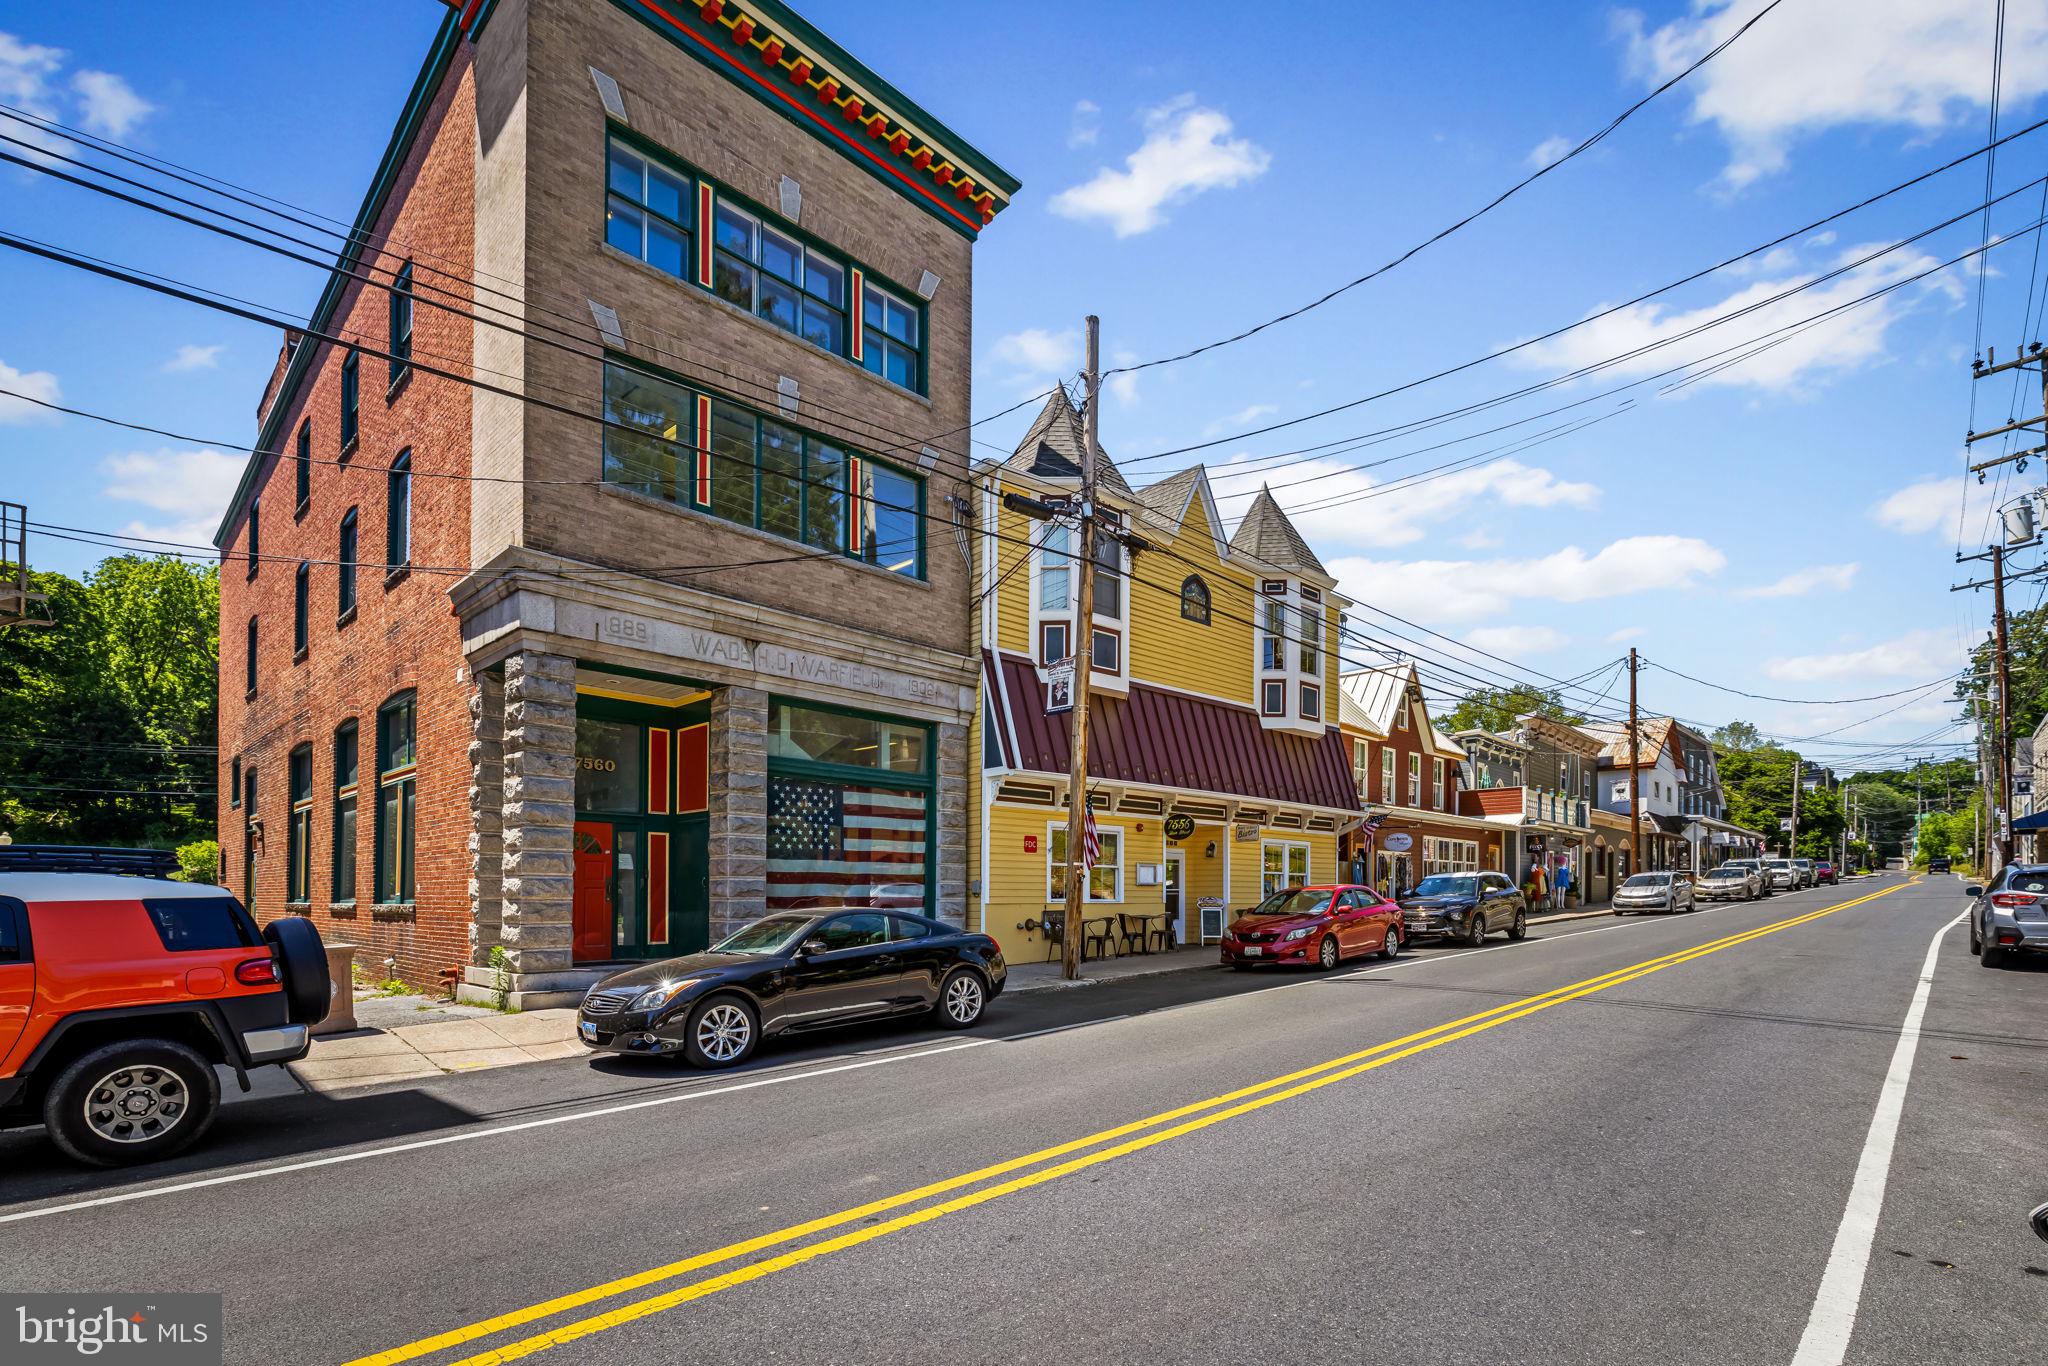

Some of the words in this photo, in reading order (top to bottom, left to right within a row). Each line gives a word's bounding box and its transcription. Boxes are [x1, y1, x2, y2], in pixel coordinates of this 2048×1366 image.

[795, 654, 880, 689] WARFIELD
[575, 756, 616, 772] 7560
[1167, 818, 1191, 830] 7556
[1025, 840, 1037, 848] FDC
